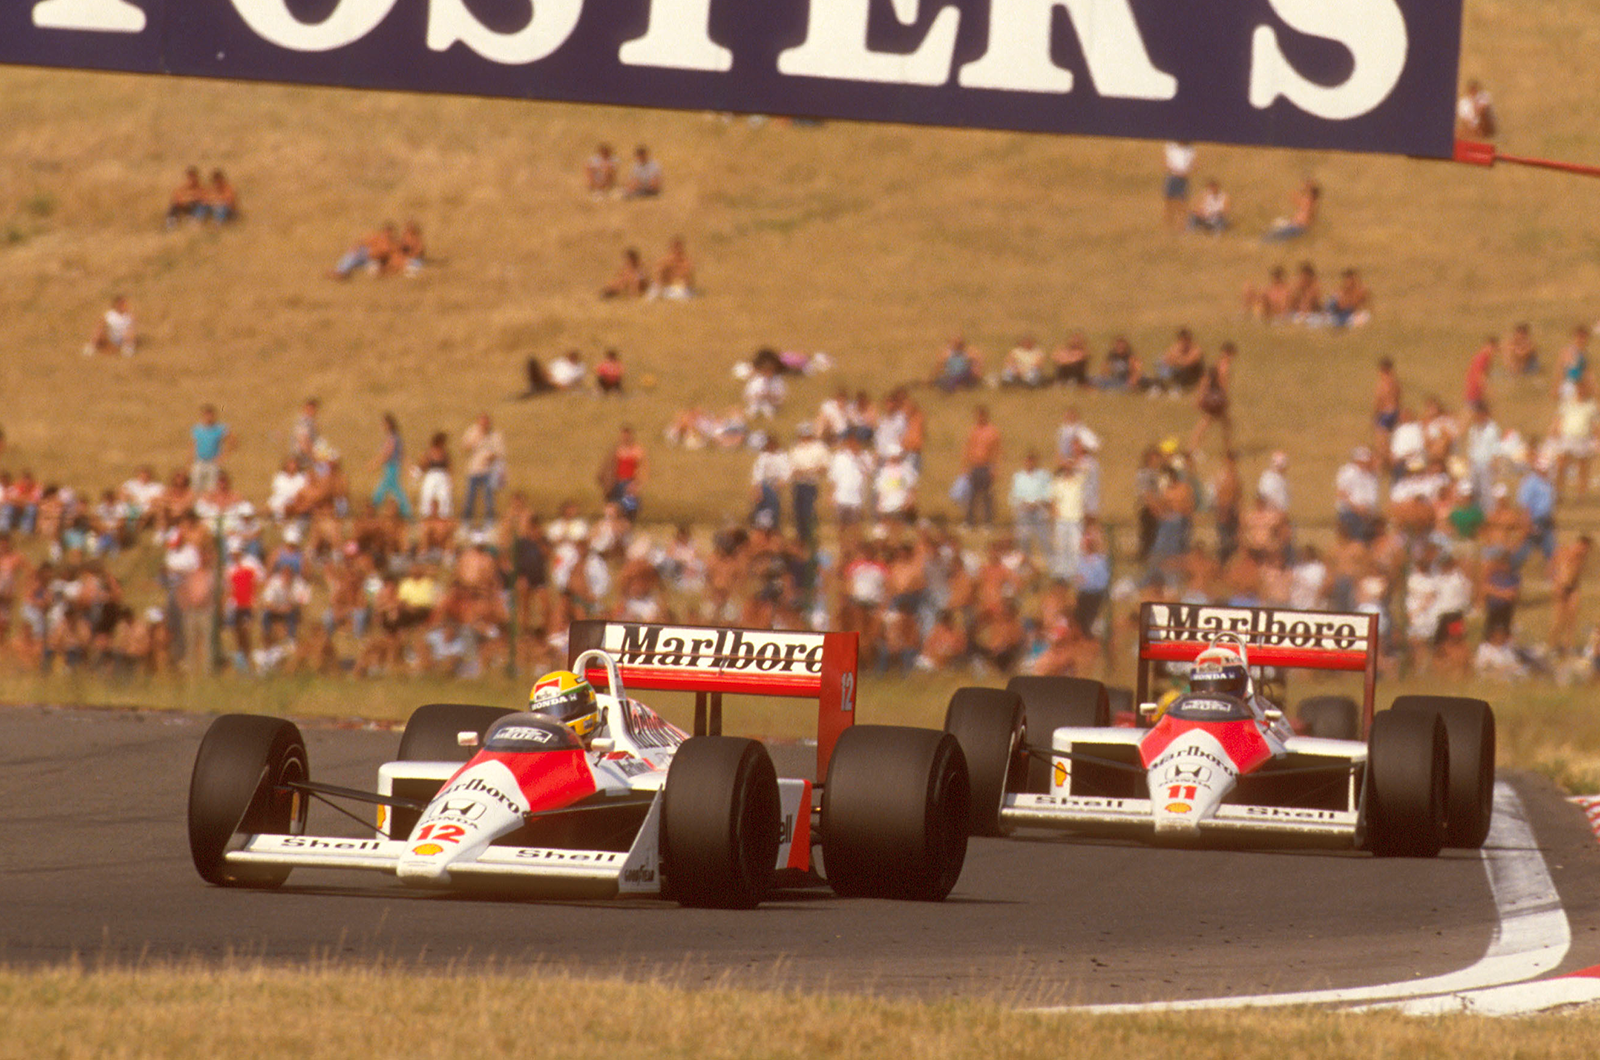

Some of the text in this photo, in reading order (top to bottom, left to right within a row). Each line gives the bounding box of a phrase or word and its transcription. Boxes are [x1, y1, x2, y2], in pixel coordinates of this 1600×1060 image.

[1161, 606, 1356, 649] Marlboro
[616, 625, 823, 673] Marlboro
[841, 671, 854, 711] 12
[531, 695, 568, 711] HONDA
[1152, 746, 1233, 777] Marlboro
[428, 779, 519, 814] rlboro
[1168, 785, 1197, 800] 11
[1035, 796, 1123, 808] Shell
[1247, 807, 1335, 818] Shell
[416, 824, 465, 844] 12
[281, 838, 380, 850] Shell
[516, 849, 616, 862] Shell
